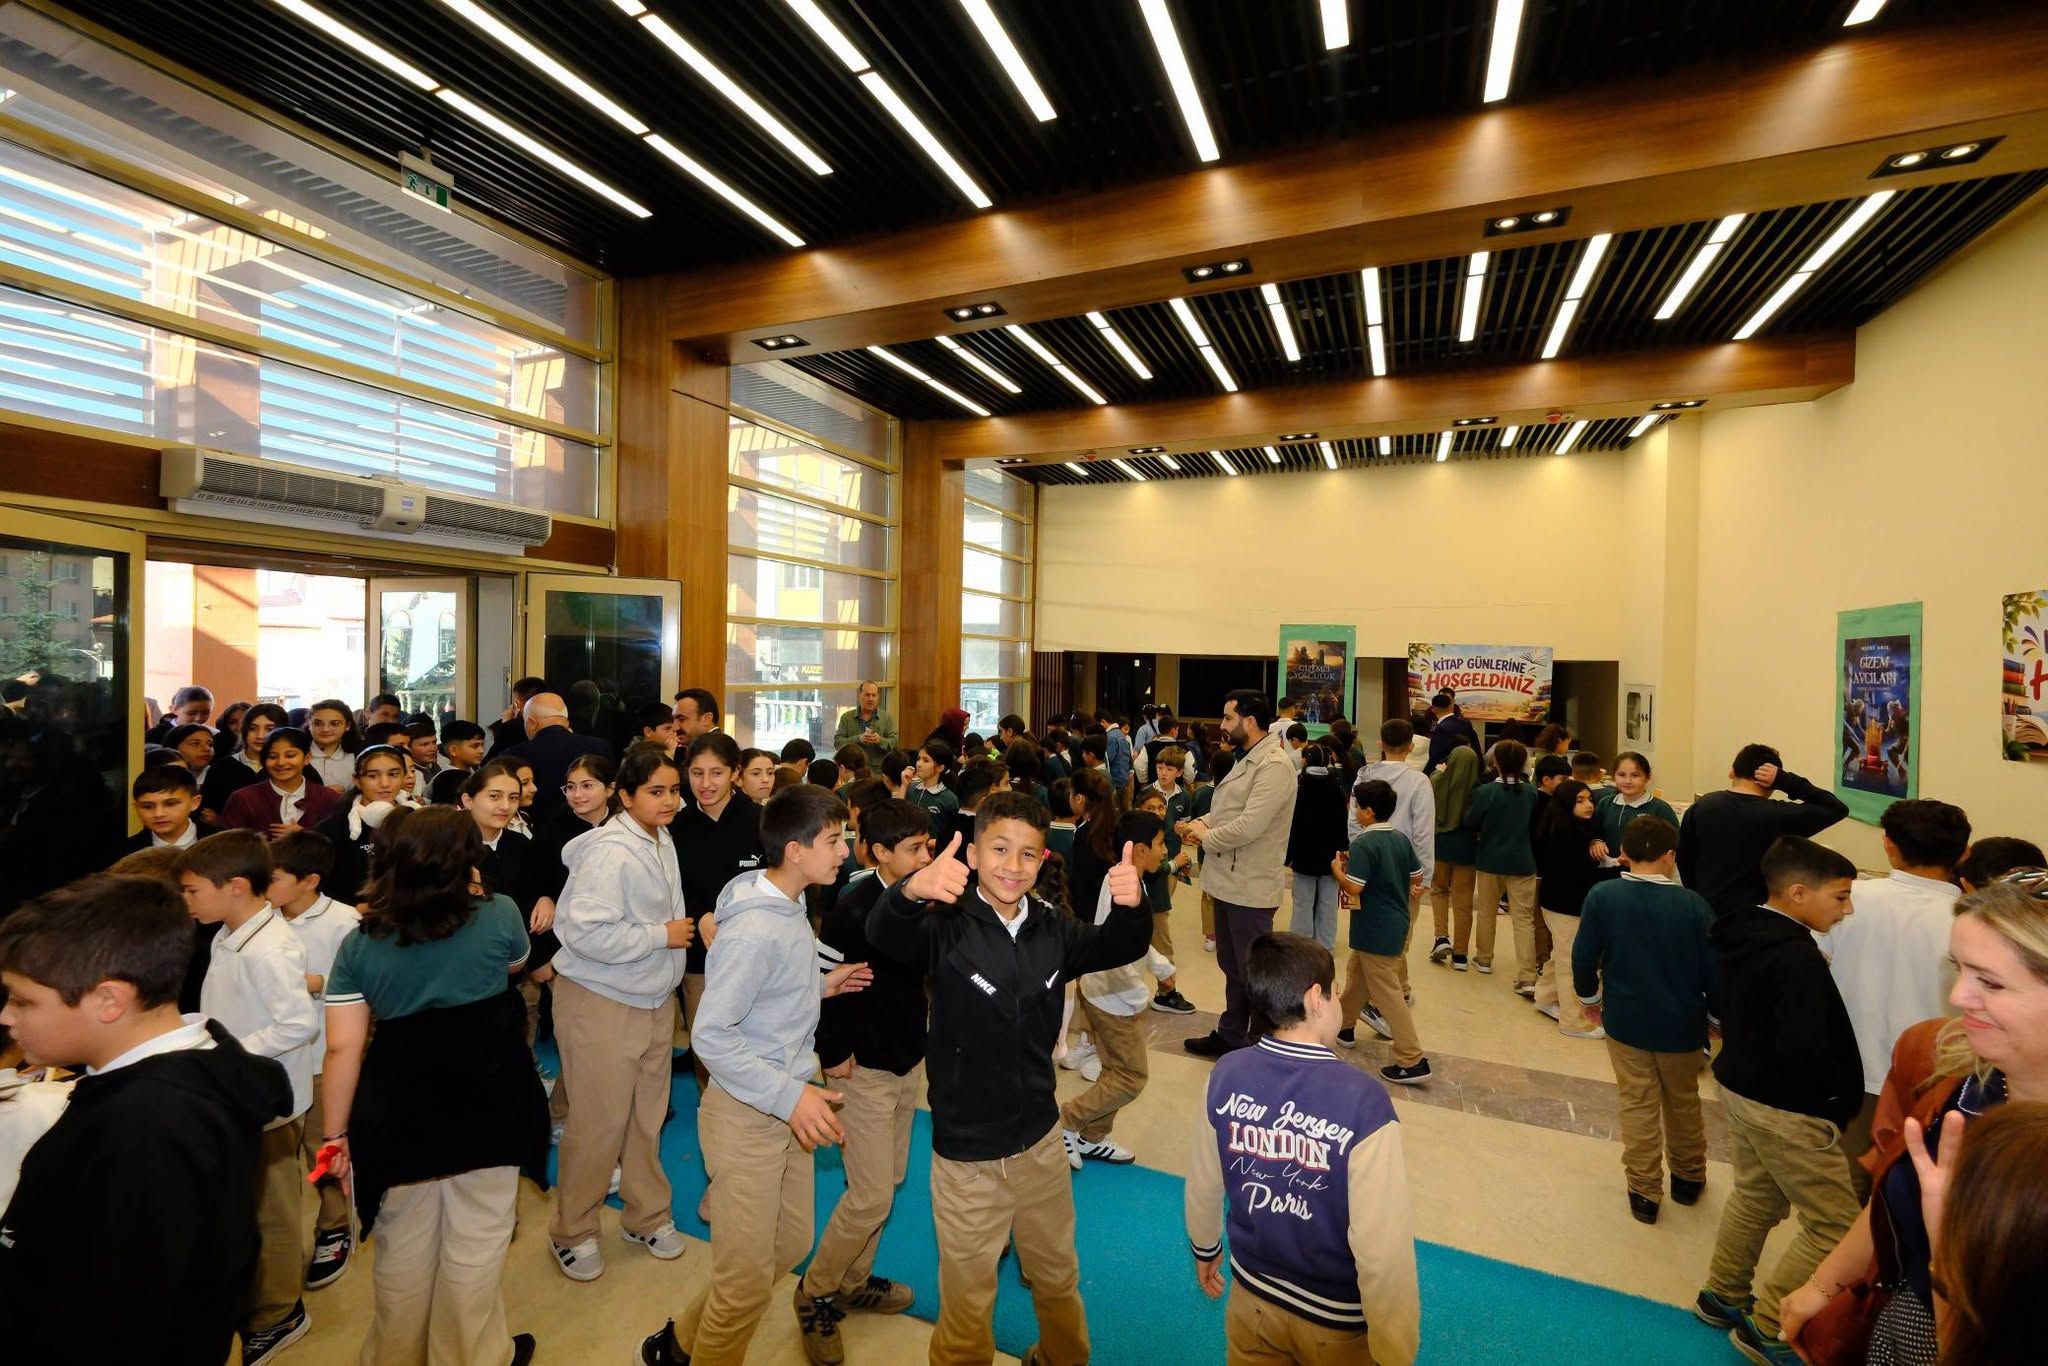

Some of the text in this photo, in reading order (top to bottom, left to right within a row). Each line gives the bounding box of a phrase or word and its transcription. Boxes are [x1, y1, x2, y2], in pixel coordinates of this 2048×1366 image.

[1433, 655, 1527, 674] KİTAP GÜNLERİNE
[1425, 671, 1537, 695] HOŞGELDİNİZ
[970, 973, 997, 996] NIKE
[1215, 1092, 1355, 1156] New Jersey
[1228, 1121, 1332, 1172] LONDON
[1229, 1156, 1329, 1192] New York
[1241, 1181, 1313, 1221] Paris
